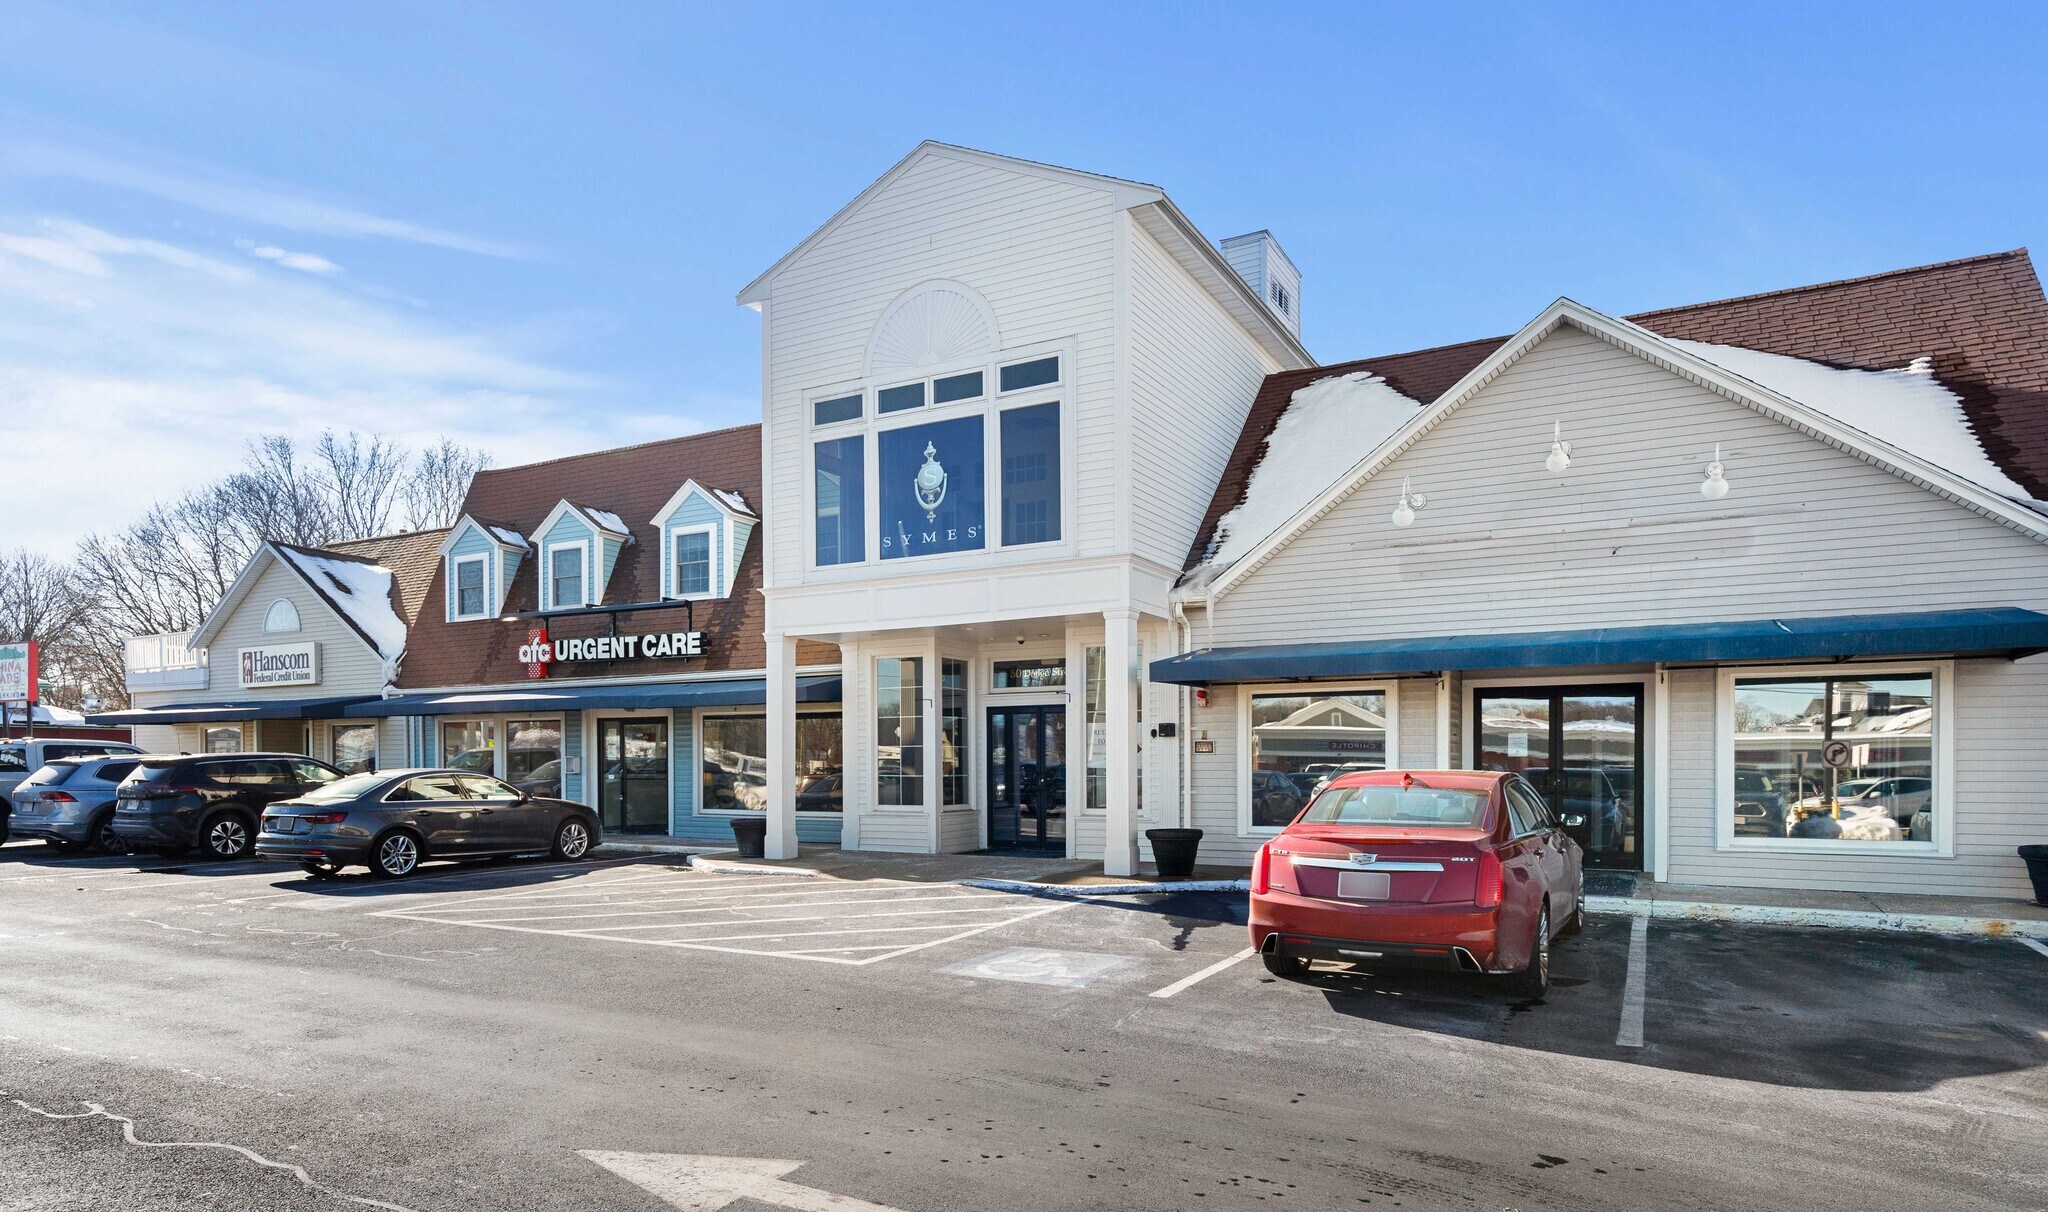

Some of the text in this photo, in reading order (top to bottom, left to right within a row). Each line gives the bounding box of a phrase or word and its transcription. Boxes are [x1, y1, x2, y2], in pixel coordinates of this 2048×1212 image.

[924, 468, 938, 486] S
[883, 526, 977, 548] SYMES
[518, 631, 701, 663] afc URGENT CARE
[253, 651, 310, 672] Hanscom
[253, 670, 311, 683] Federal Credit Union
[1010, 666, 1067, 680] 50 Dodge Str
